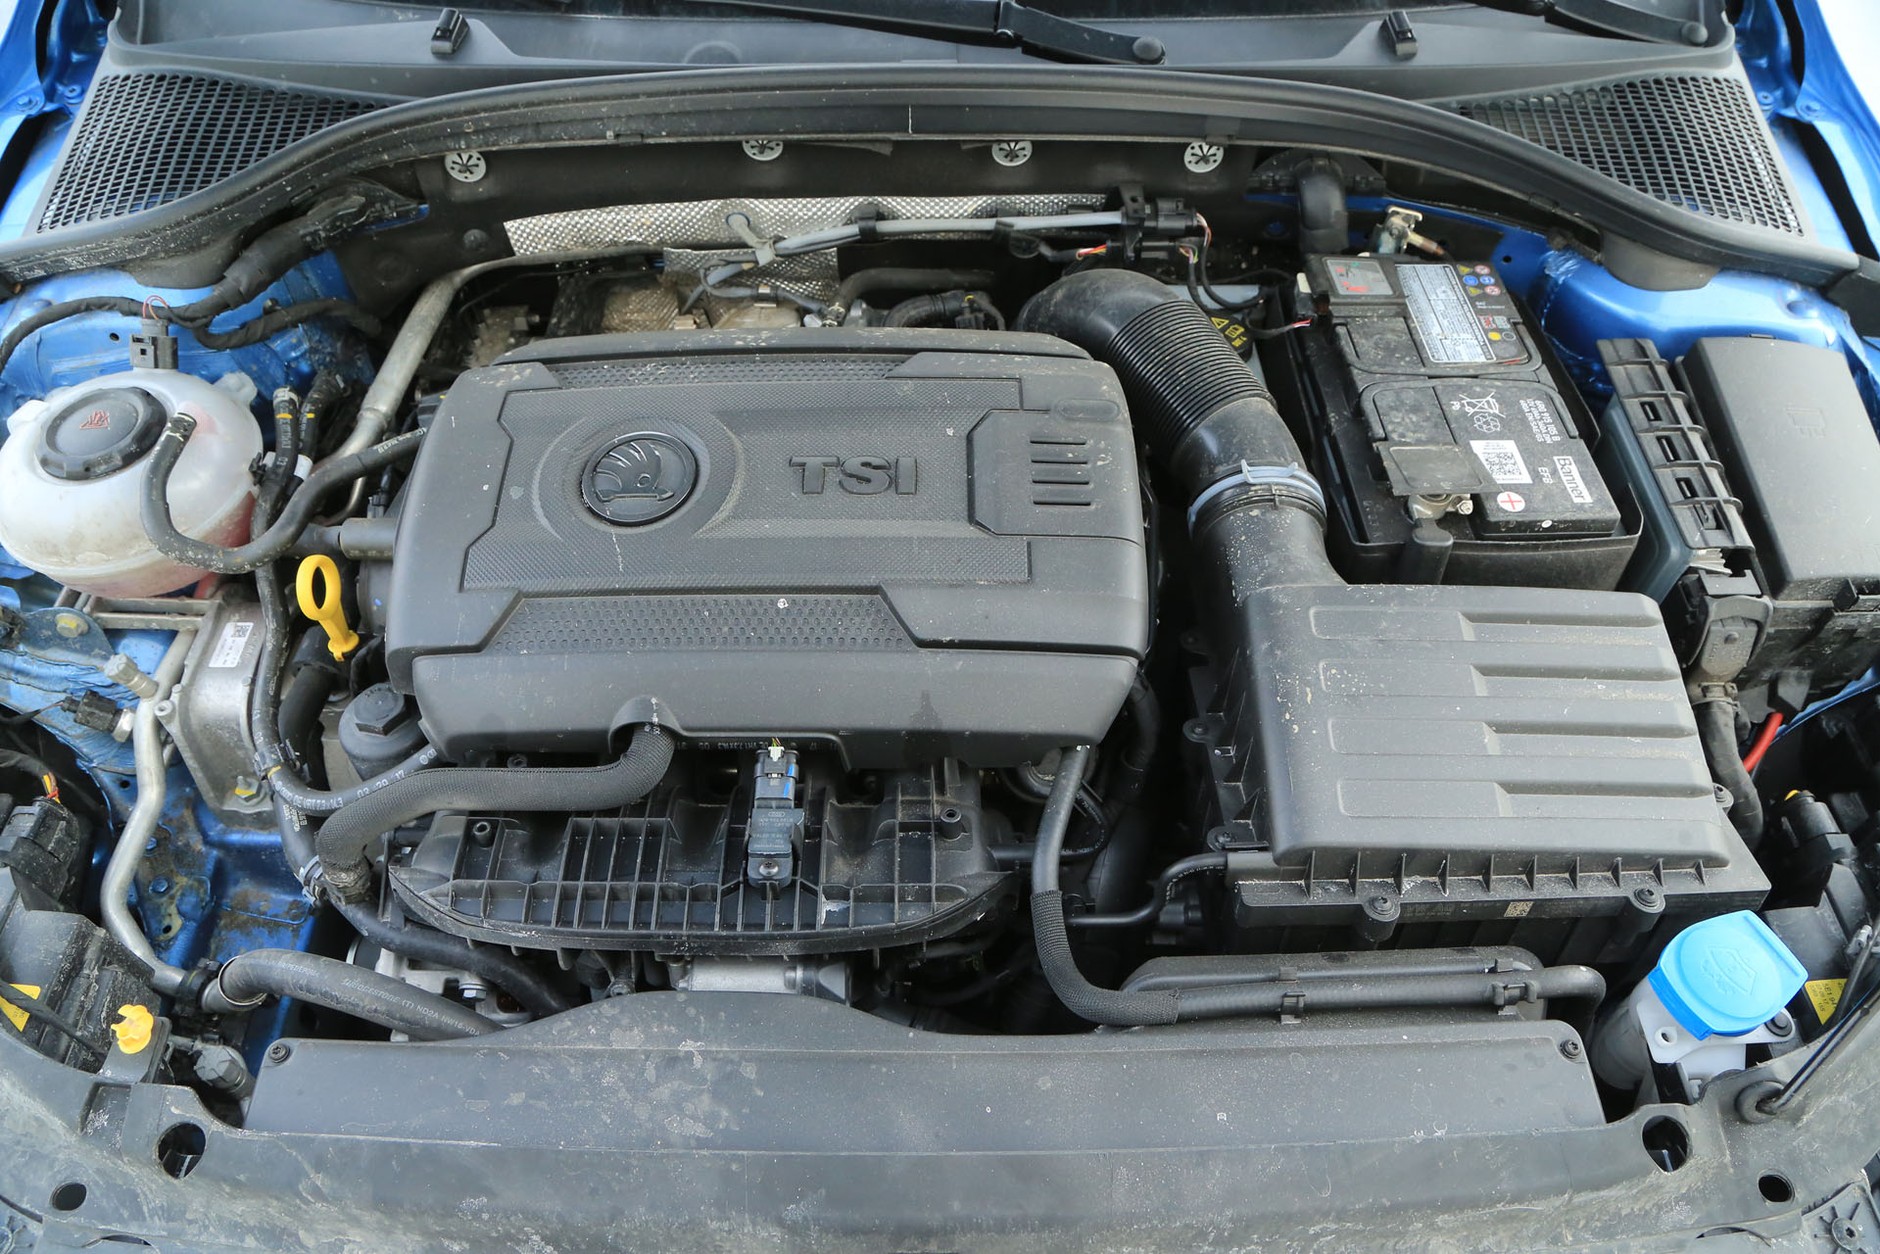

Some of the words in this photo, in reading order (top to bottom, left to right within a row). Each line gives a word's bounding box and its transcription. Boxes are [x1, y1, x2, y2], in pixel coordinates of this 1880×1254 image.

[789, 454, 919, 496] TSI
[1538, 466, 1554, 485] EFB
[1557, 457, 1586, 501] Banner
[415, 1005, 440, 1021] ND2A
